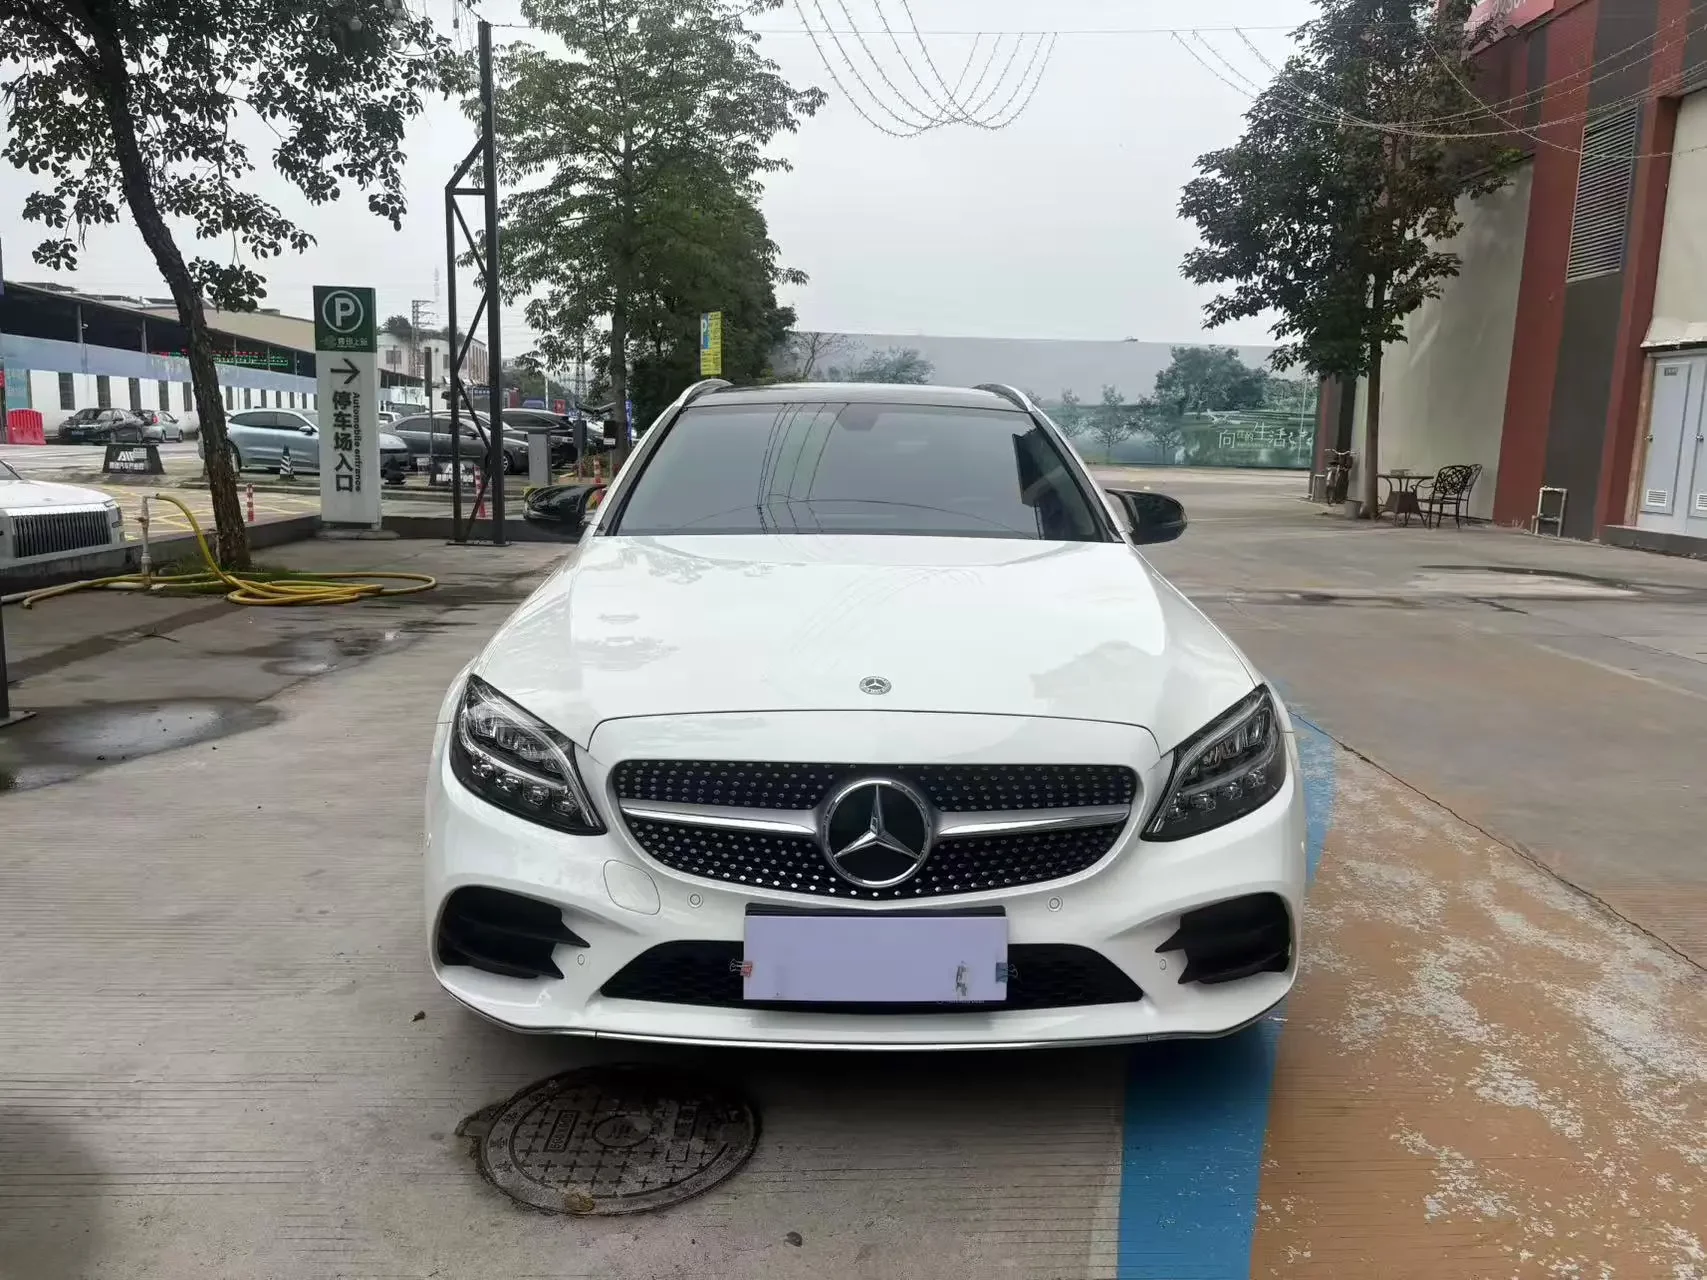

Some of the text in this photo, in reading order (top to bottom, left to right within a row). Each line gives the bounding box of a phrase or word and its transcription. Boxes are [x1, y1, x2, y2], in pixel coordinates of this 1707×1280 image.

[334, 297, 355, 327] P
[333, 390, 353, 492] 停车场入口
[353, 392, 362, 492] Automobile entrance
